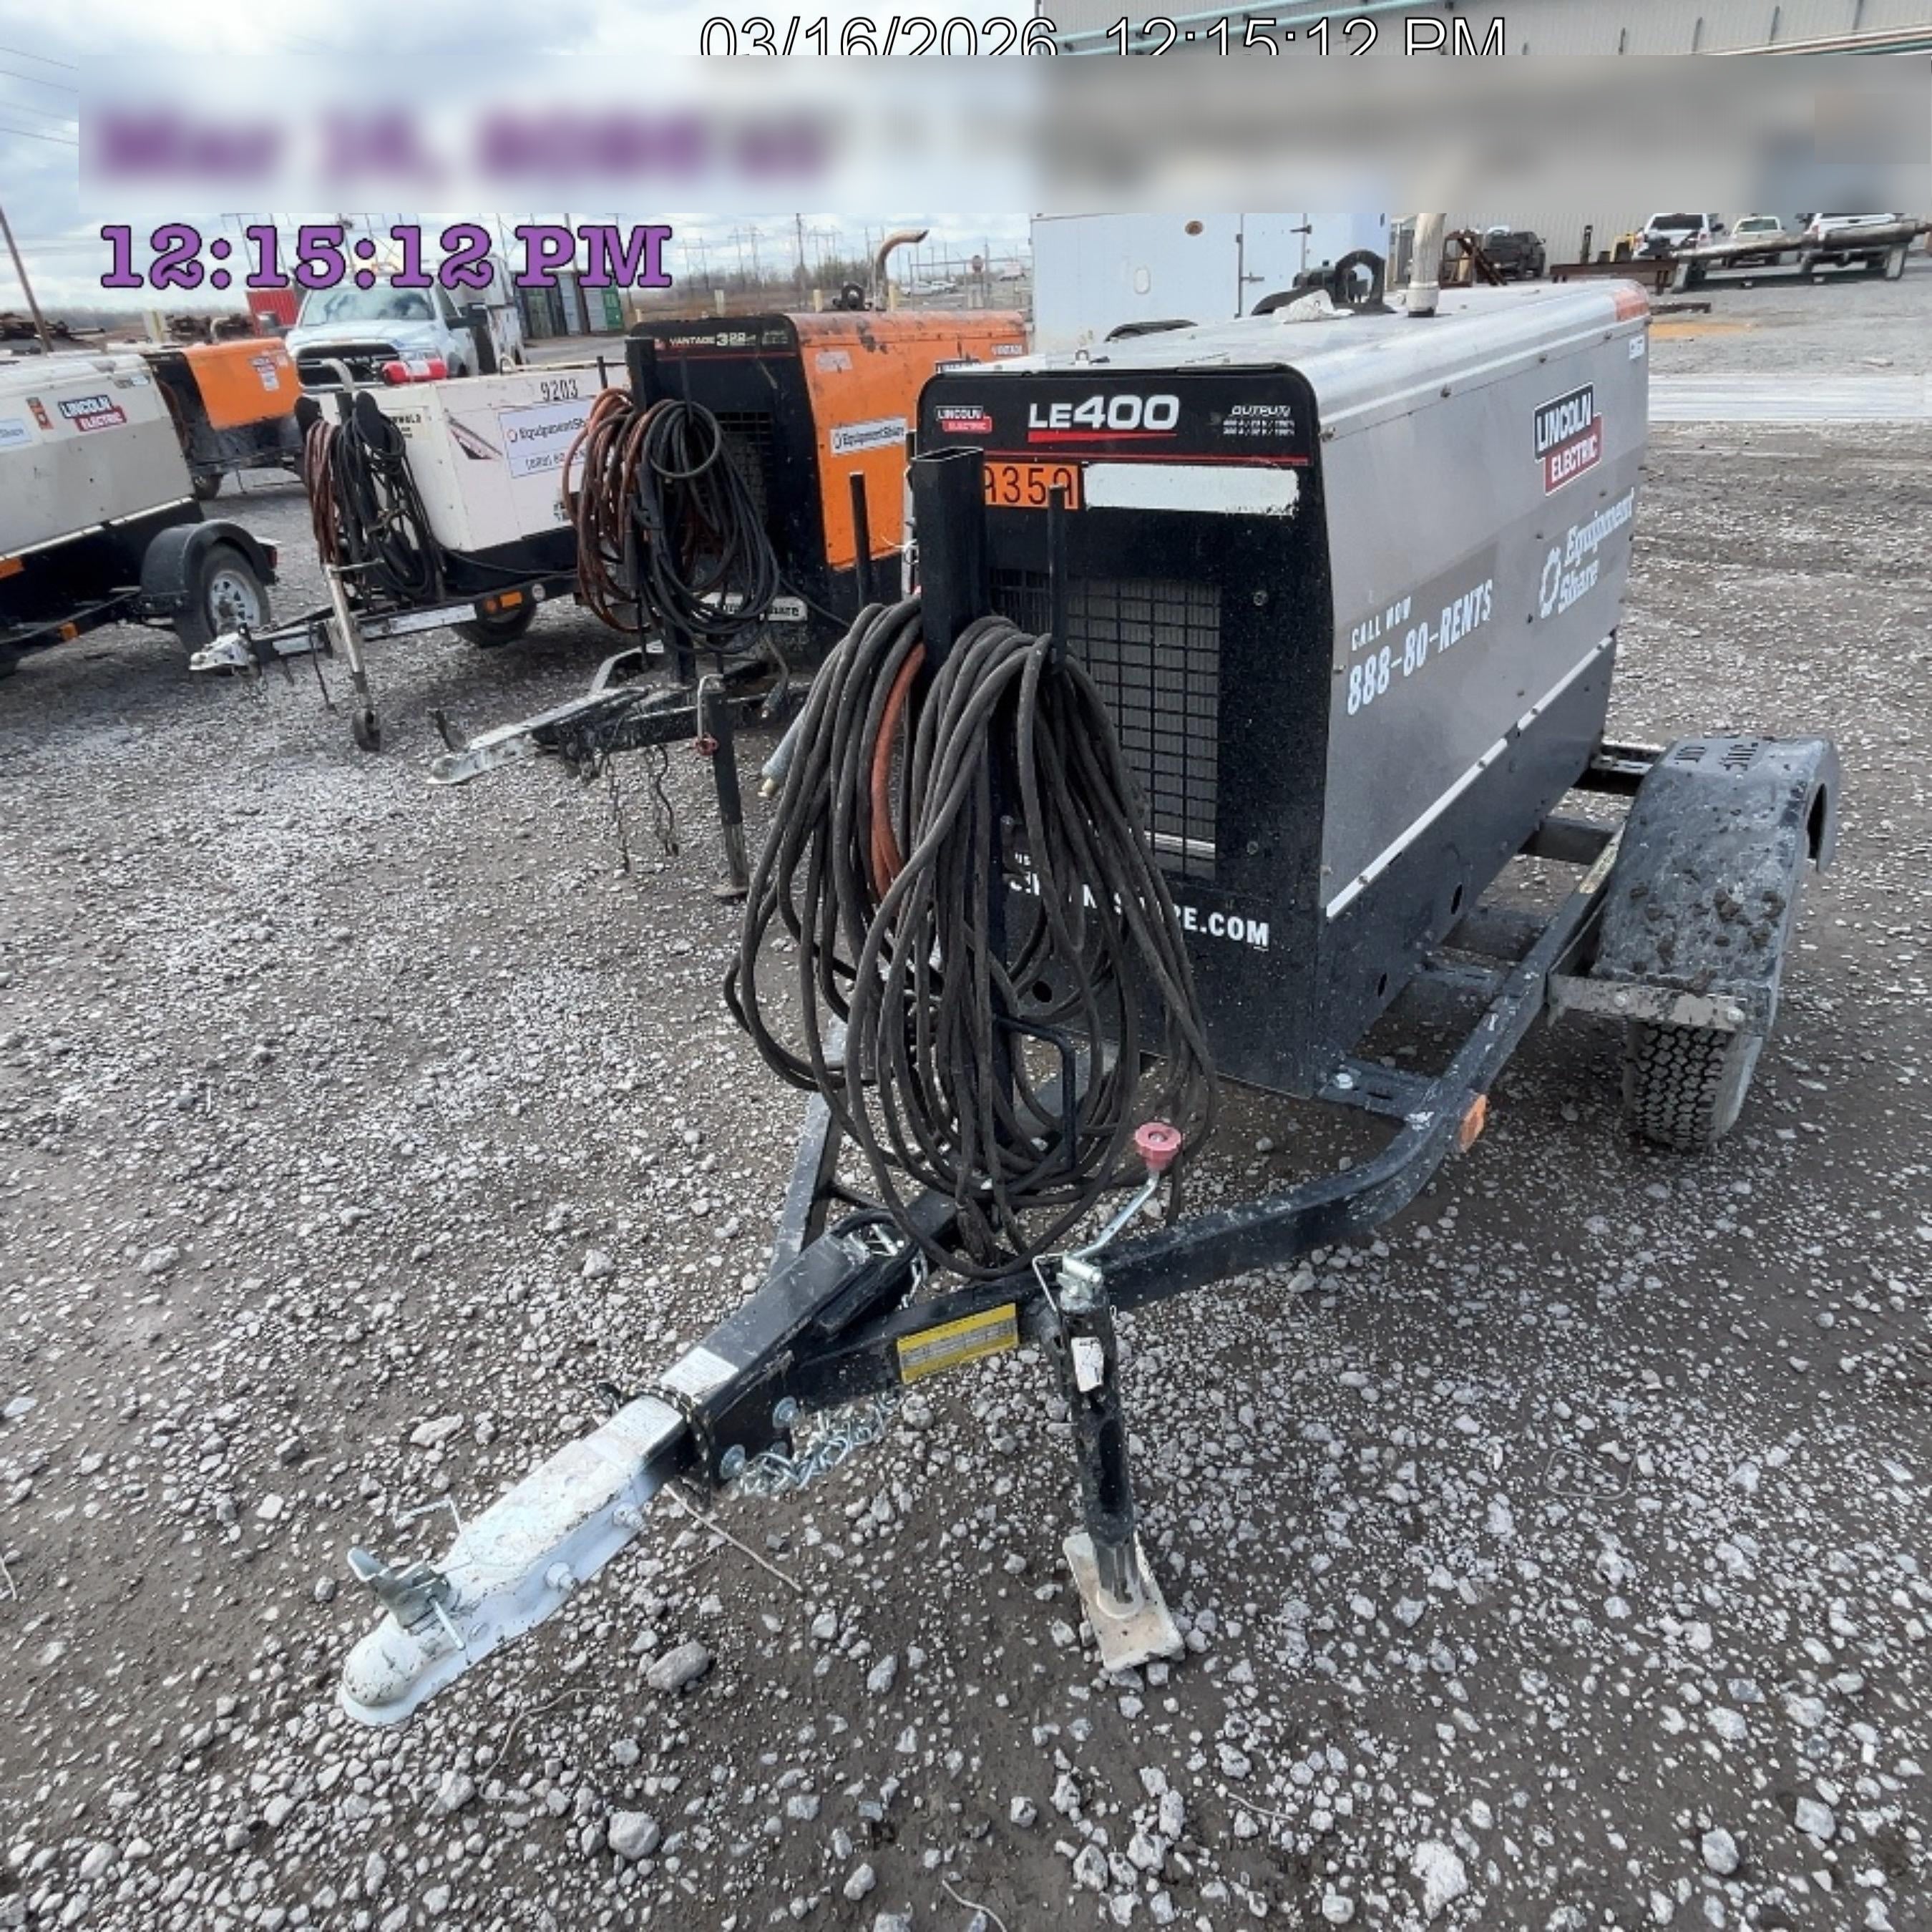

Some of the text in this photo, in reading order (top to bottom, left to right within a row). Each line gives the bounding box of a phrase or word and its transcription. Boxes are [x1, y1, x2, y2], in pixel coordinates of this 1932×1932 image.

[61, 394, 112, 418] LINCOLN
[540, 379, 579, 402] 9203
[937, 409, 982, 420] LINCOLN
[1028, 394, 1180, 430] LE400
[1536, 392, 1592, 452] LINCOLN
[1551, 433, 1598, 483] ELECTRIC
[1564, 486, 1634, 567] Equipment
[1558, 559, 1599, 615] Share
[1347, 578, 1493, 716] 888-80-RENTS
[1352, 595, 1411, 652] CALL NOW
